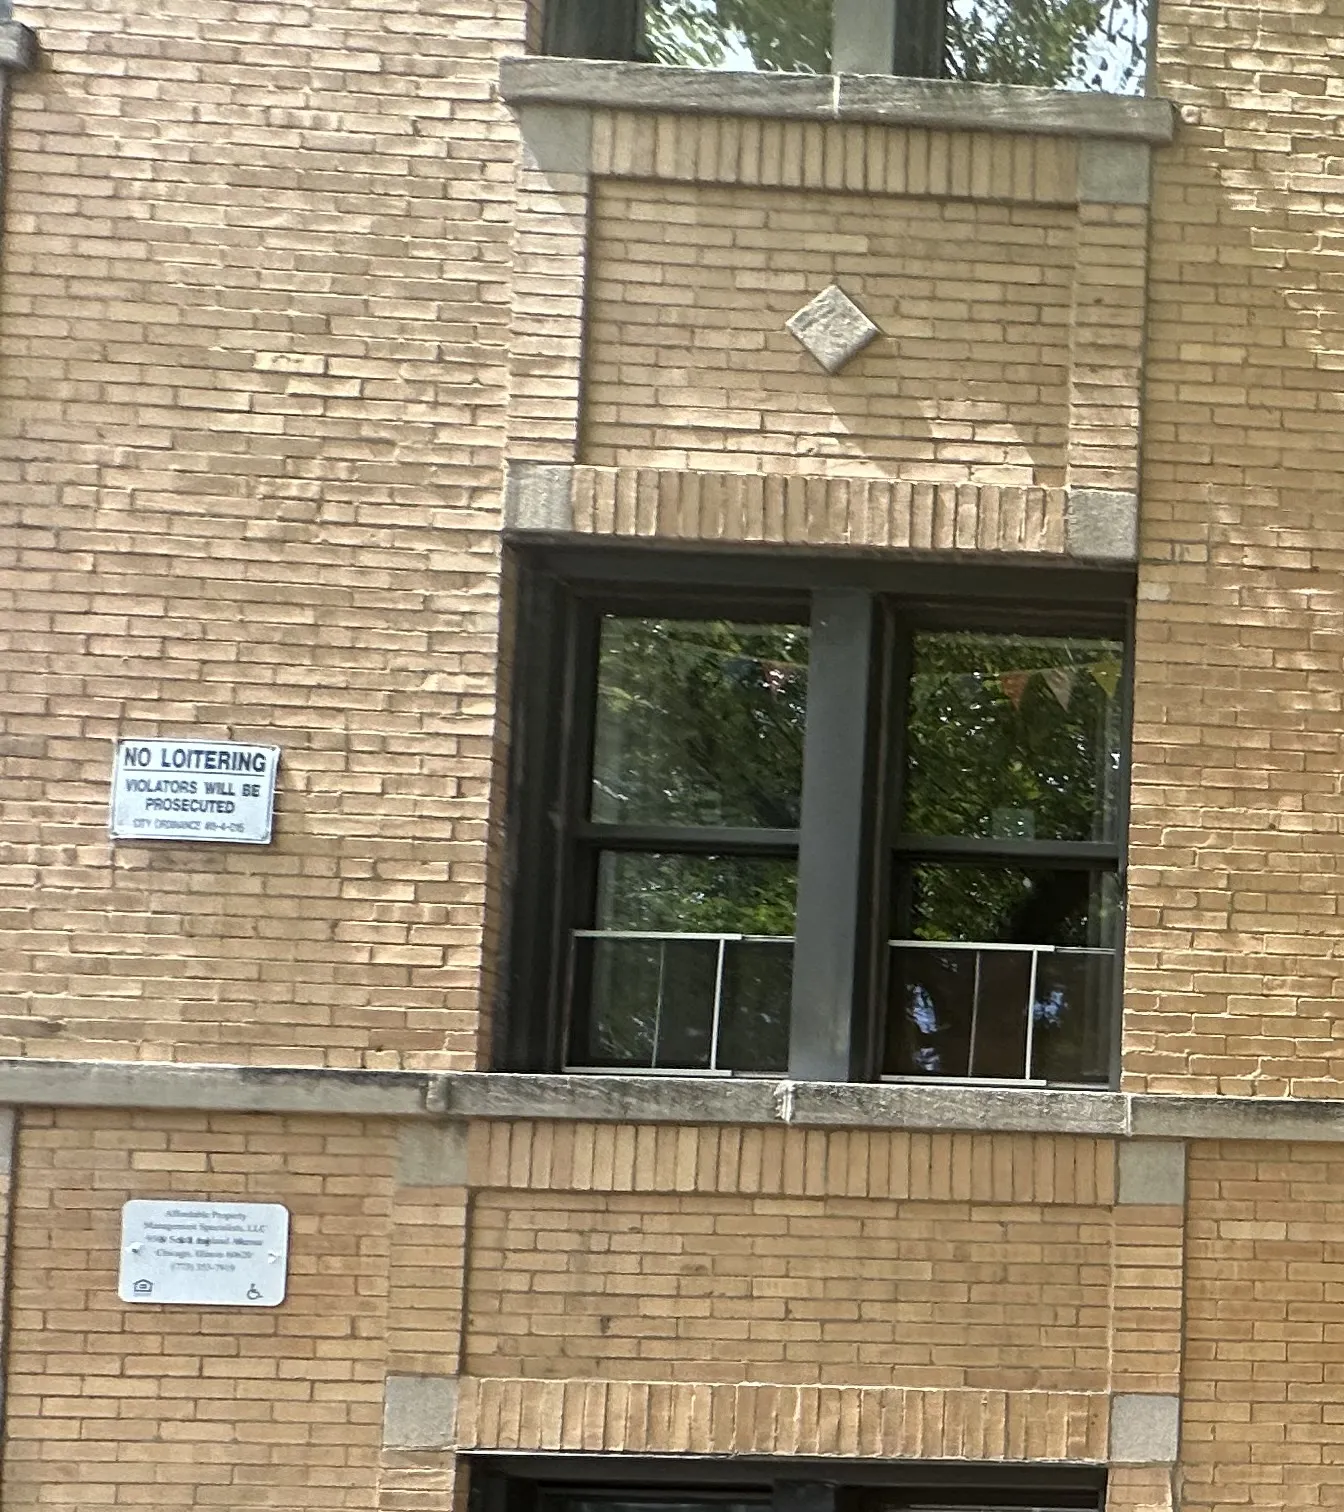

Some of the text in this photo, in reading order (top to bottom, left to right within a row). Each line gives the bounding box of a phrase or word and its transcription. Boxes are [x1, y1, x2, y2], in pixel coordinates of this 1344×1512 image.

[124, 747, 267, 772] NO LOITERING
[125, 778, 261, 797] VIOLATORS WILL BE
[145, 798, 236, 814] PROSECUTED
